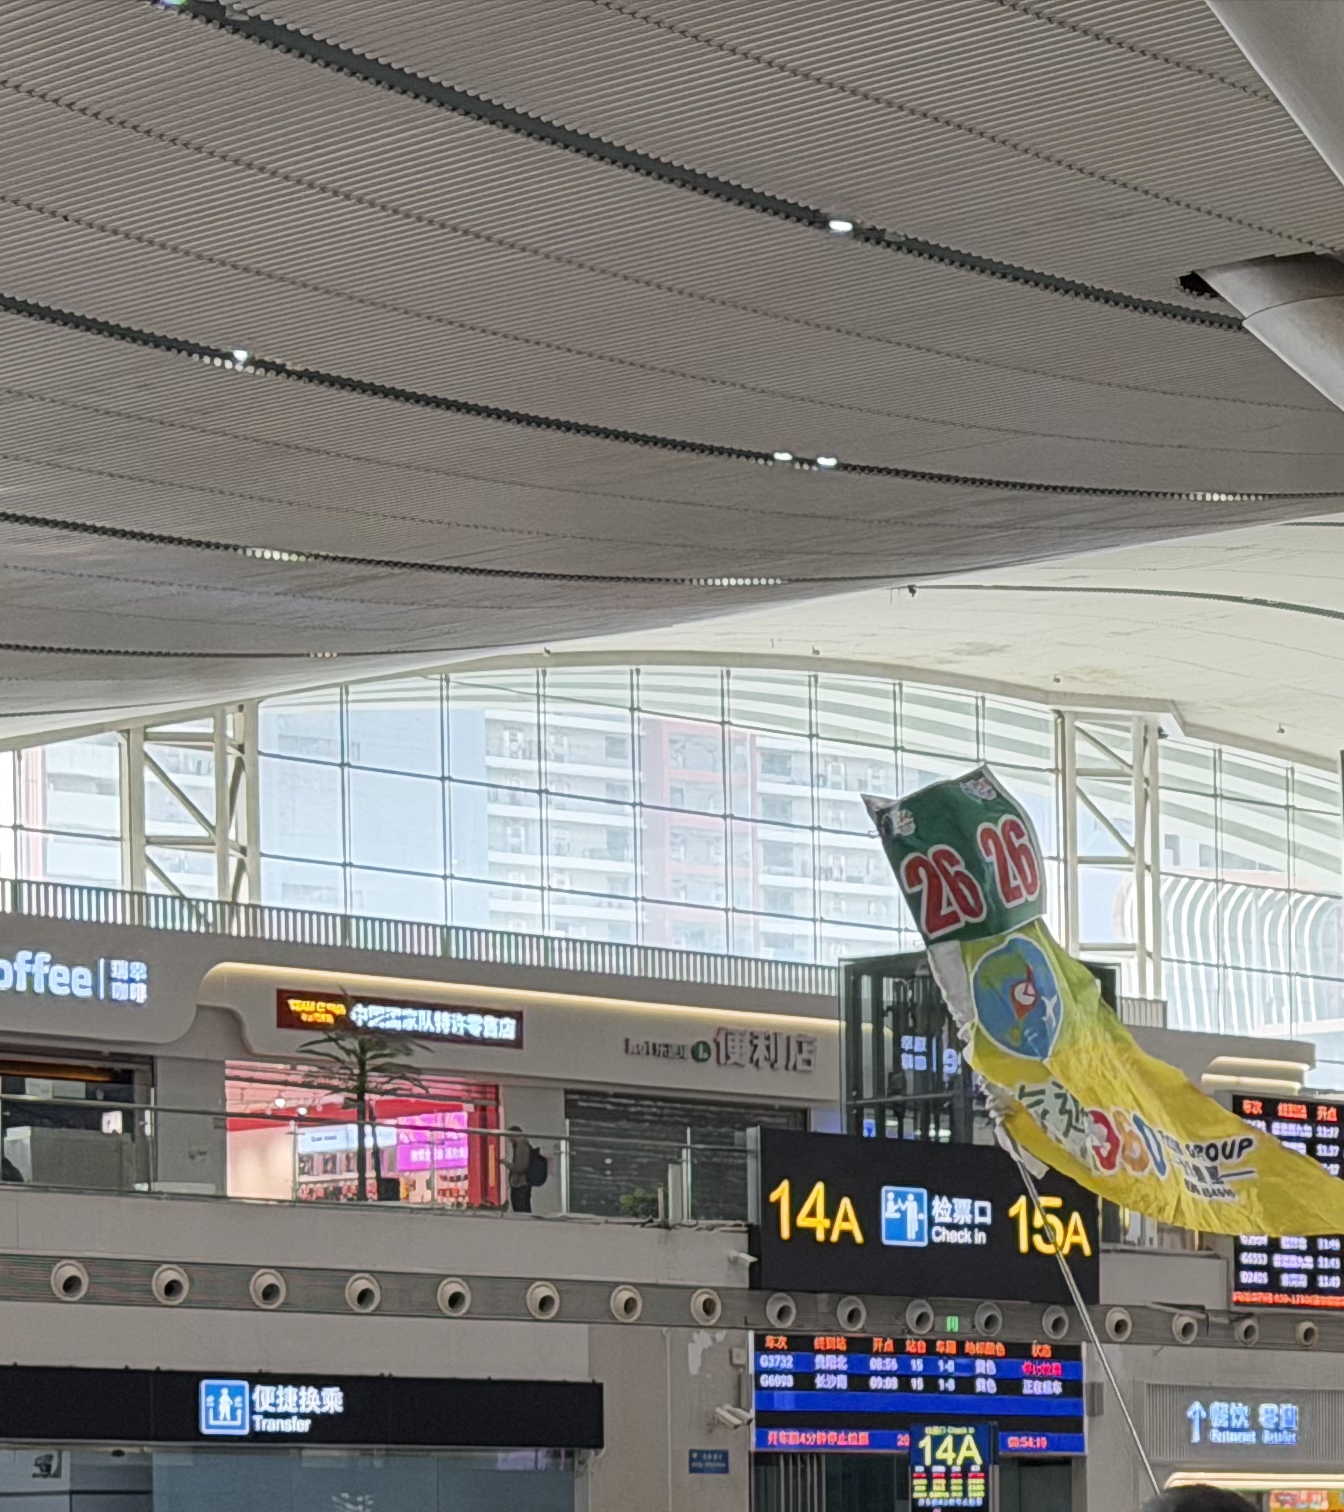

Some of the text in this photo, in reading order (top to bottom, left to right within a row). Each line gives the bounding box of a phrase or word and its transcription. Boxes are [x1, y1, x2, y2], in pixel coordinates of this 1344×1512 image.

[977, 815, 1040, 908] 26
[901, 845, 987, 938] 26
[769, 1178, 865, 1244] 14A
[932, 1195, 992, 1224] 检票口
[931, 1226, 987, 1245] Check in
[1008, 1195, 1092, 1257] 15A
[252, 1384, 344, 1414] 便捷换乘
[252, 1415, 312, 1433] Transfer
[918, 1434, 984, 1466] 14A
